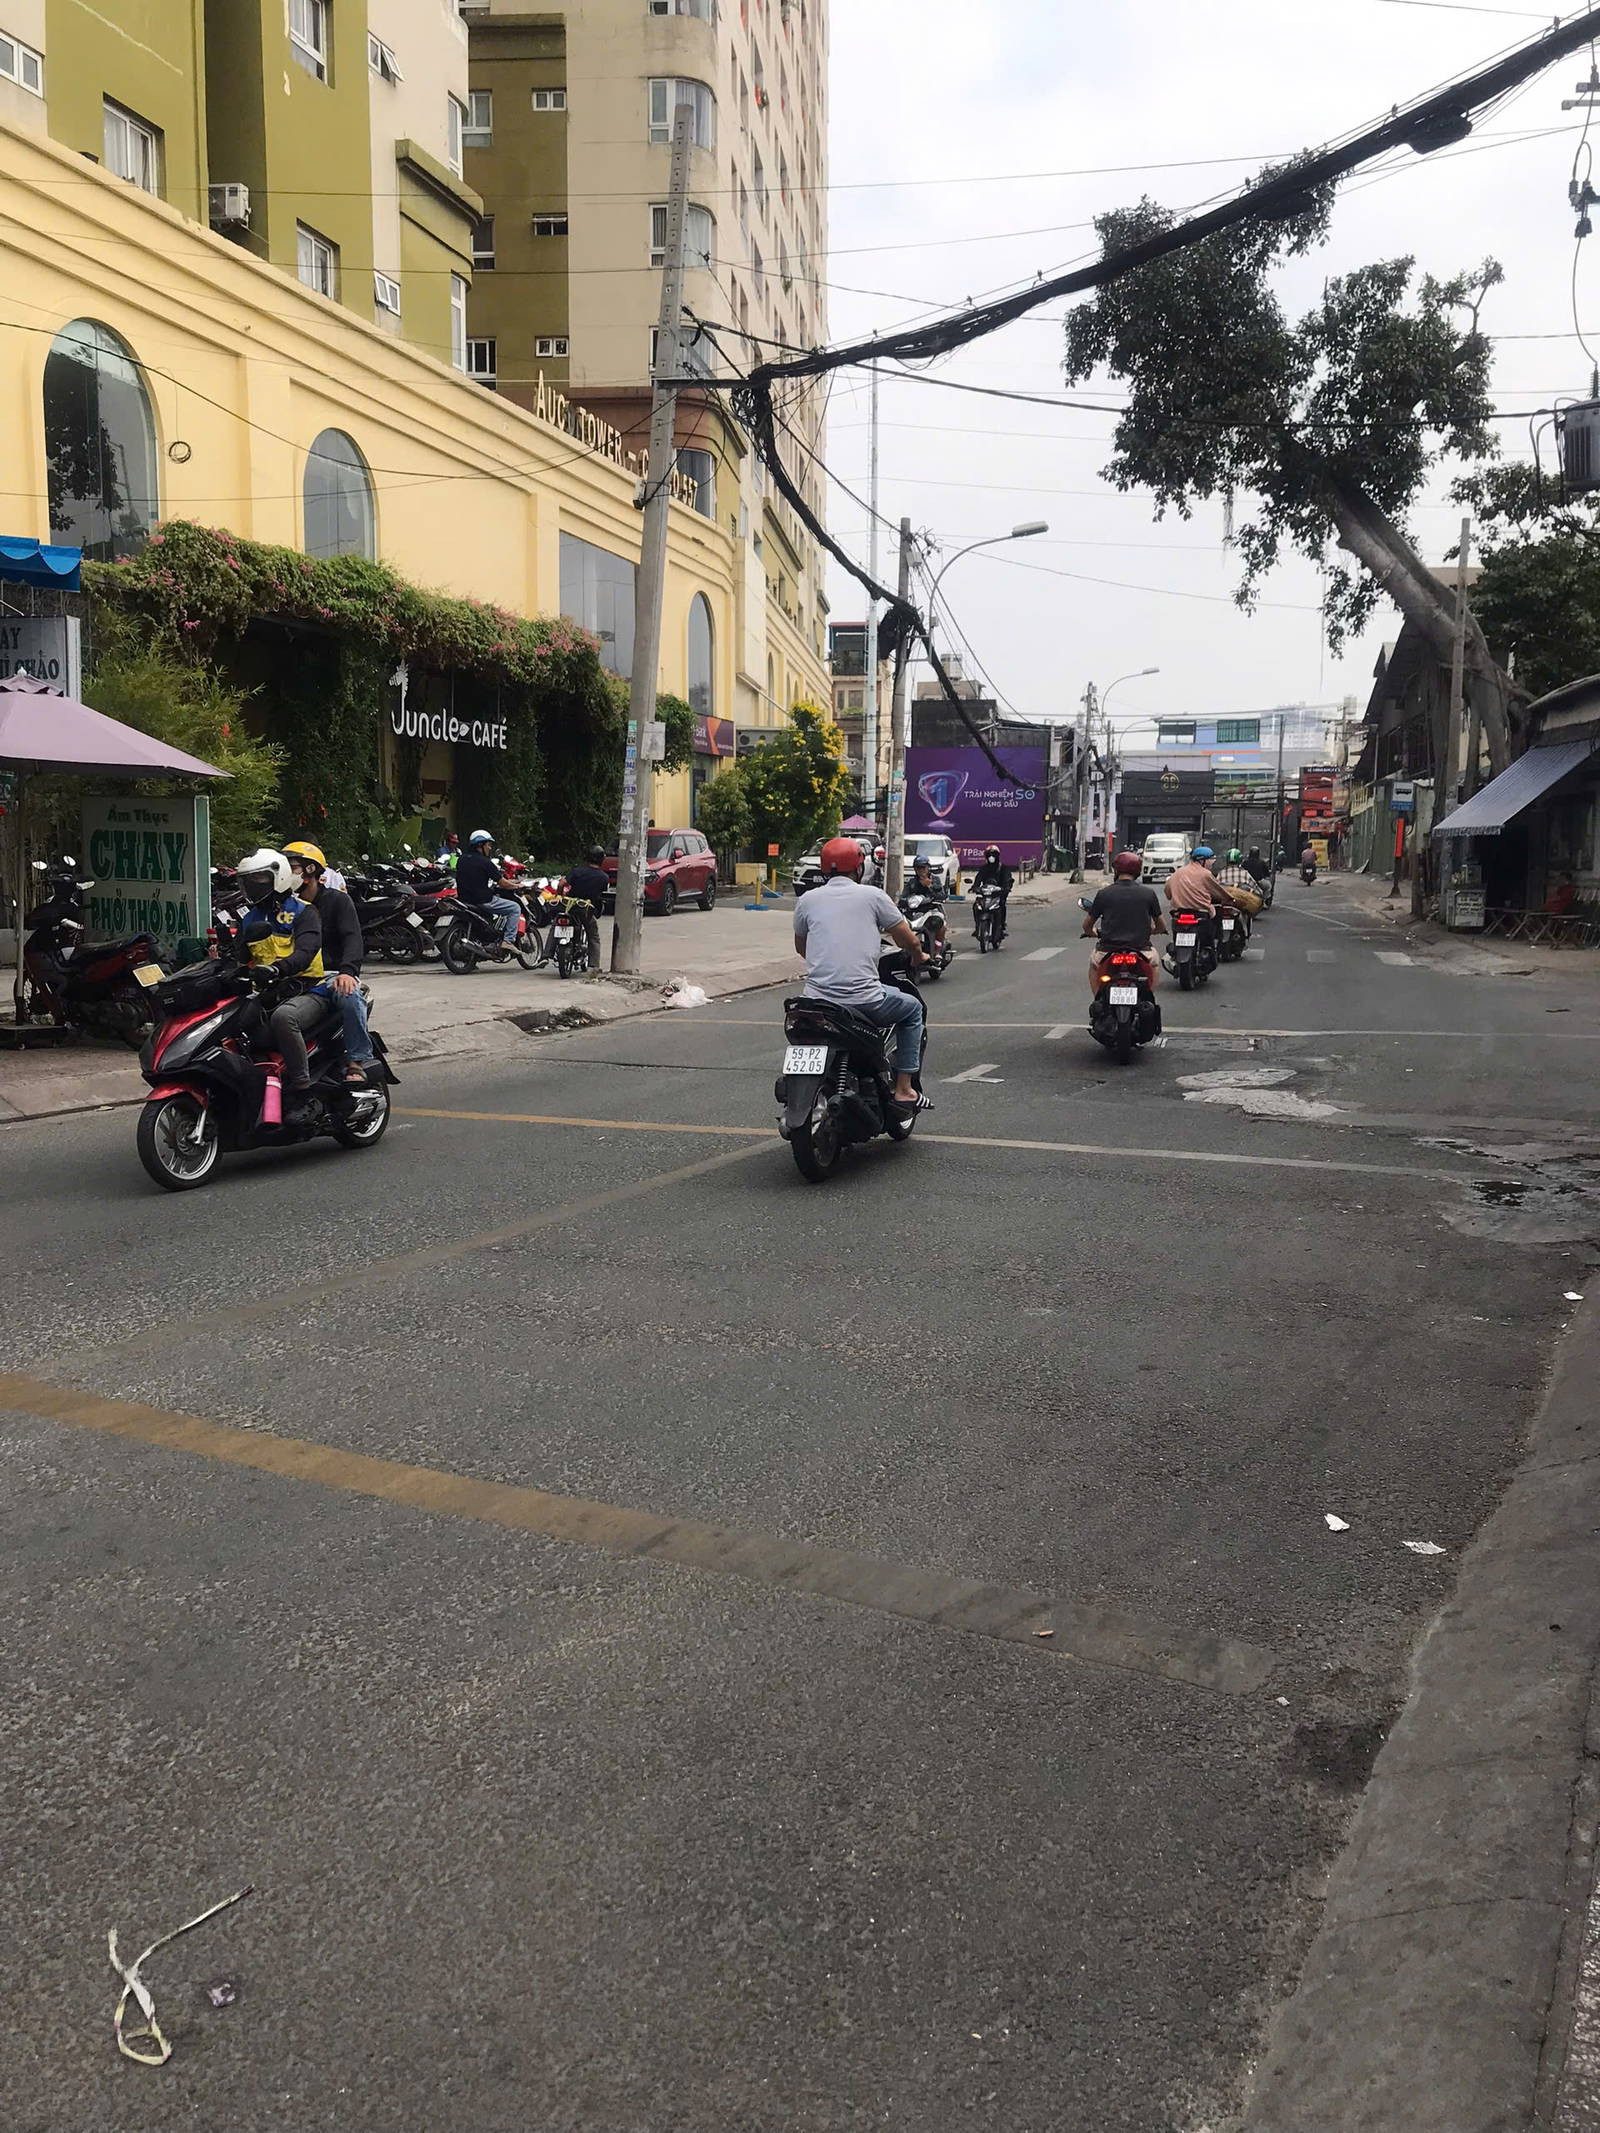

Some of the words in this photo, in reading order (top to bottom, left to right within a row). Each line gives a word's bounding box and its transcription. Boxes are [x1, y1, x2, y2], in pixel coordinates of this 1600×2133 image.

[579, 406, 622, 467] TOWER
[472, 717, 508, 750] CAFÉ
[90, 828, 188, 884] CHAY
[90, 888, 127, 931] PHỞ
[792, 1048, 821, 1060] 59-P2
